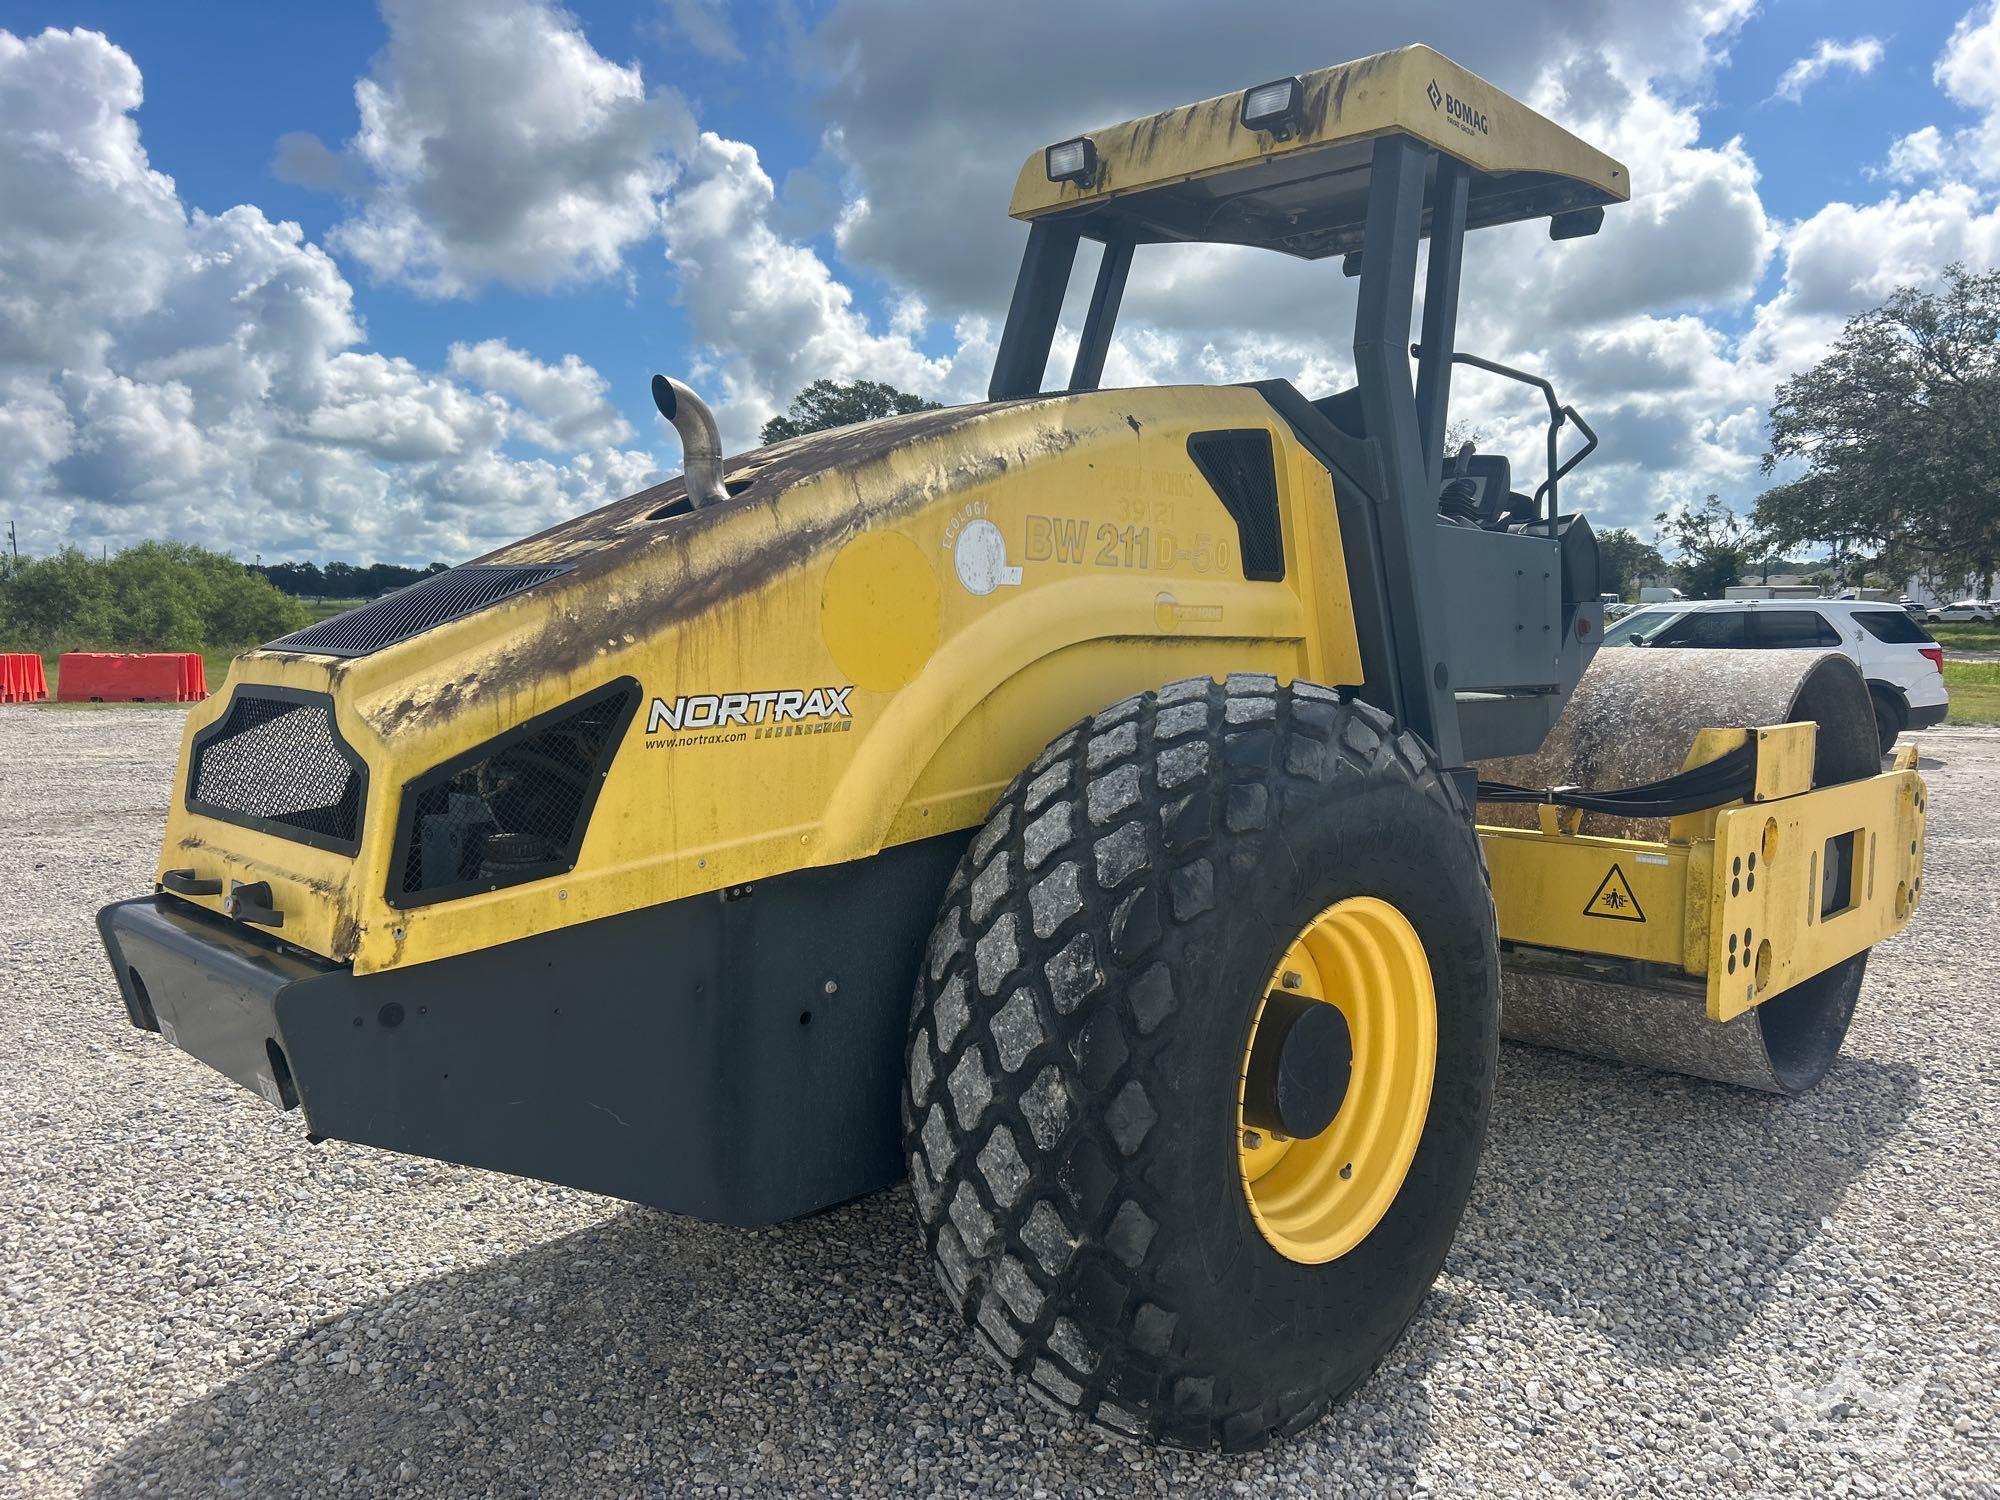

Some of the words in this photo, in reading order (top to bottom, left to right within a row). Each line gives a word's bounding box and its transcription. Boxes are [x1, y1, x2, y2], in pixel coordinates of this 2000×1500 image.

[1446, 93, 1488, 135] BOMAG
[942, 500, 990, 550] ECOLOGY
[1025, 514, 1089, 565] BW
[645, 685, 854, 734] NORTRAX
[645, 731, 747, 750] www.nortrax.com
